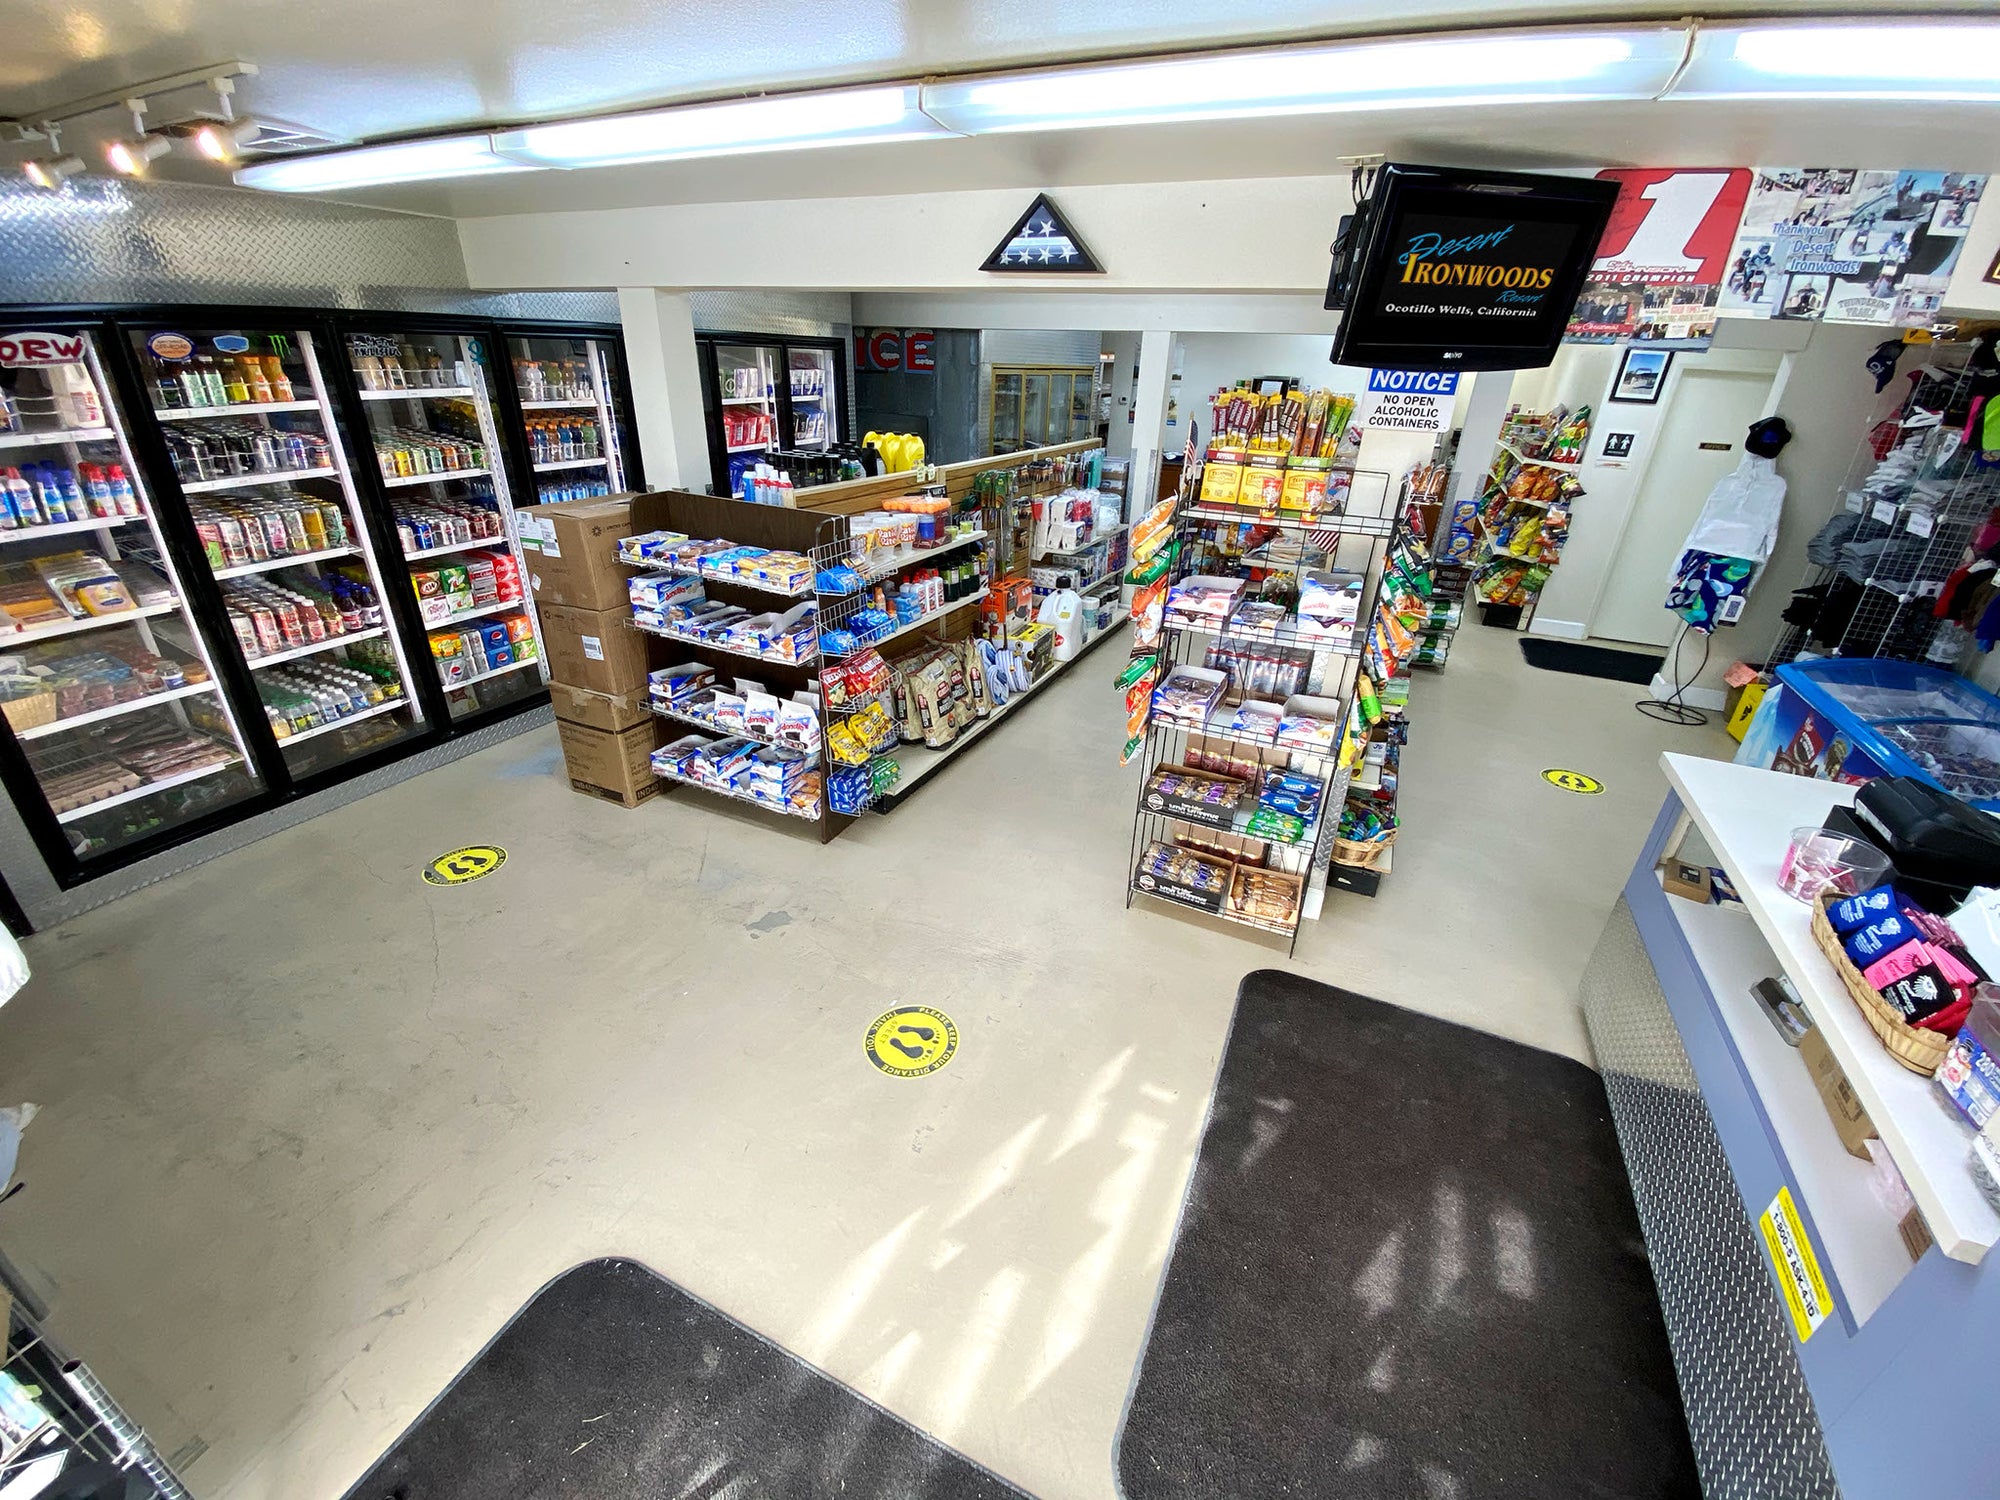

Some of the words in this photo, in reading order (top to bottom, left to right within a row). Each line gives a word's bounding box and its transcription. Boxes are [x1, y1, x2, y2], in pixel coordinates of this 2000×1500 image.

[1592, 173, 1731, 273] 1
[1773, 223, 1803, 234] Thank
[1804, 226, 1825, 238] you
[1399, 224, 1516, 264] Desert
[1793, 240, 1835, 253] Desert
[1400, 253, 1555, 289] IRONWOODS
[1790, 259, 1861, 274] Ironwoods!
[1586, 274, 1617, 282] 2011
[1622, 274, 1696, 283] CHAMPION
[1496, 290, 1544, 303] Resort
[1838, 297, 1891, 312] THUNDERING
[1385, 303, 1435, 313] Ocotillo
[1439, 305, 1474, 316] Wells,
[1477, 306, 1537, 317] California
[1846, 307, 1877, 318] TRAILS
[0, 337, 83, 360] ORW
[855, 328, 936, 373] ICE
[1372, 370, 1456, 391] NOTICE
[1383, 395, 1400, 404] NO
[1404, 396, 1435, 406] OPEN
[1374, 406, 1439, 418] ALCOHOLIC
[1369, 416, 1440, 430] CONTAINERS
[872, 1011, 898, 1031] THANK
[919, 1007, 949, 1025] PLEASE
[866, 1033, 875, 1052] YOU
[948, 1025, 957, 1046] KEEP
[933, 1049, 953, 1070] YOUR
[881, 1063, 931, 1077] DISTANCE
[1773, 1212, 1793, 1258] 1-800-5
[1790, 1260, 1814, 1317] ASK-4-ID
